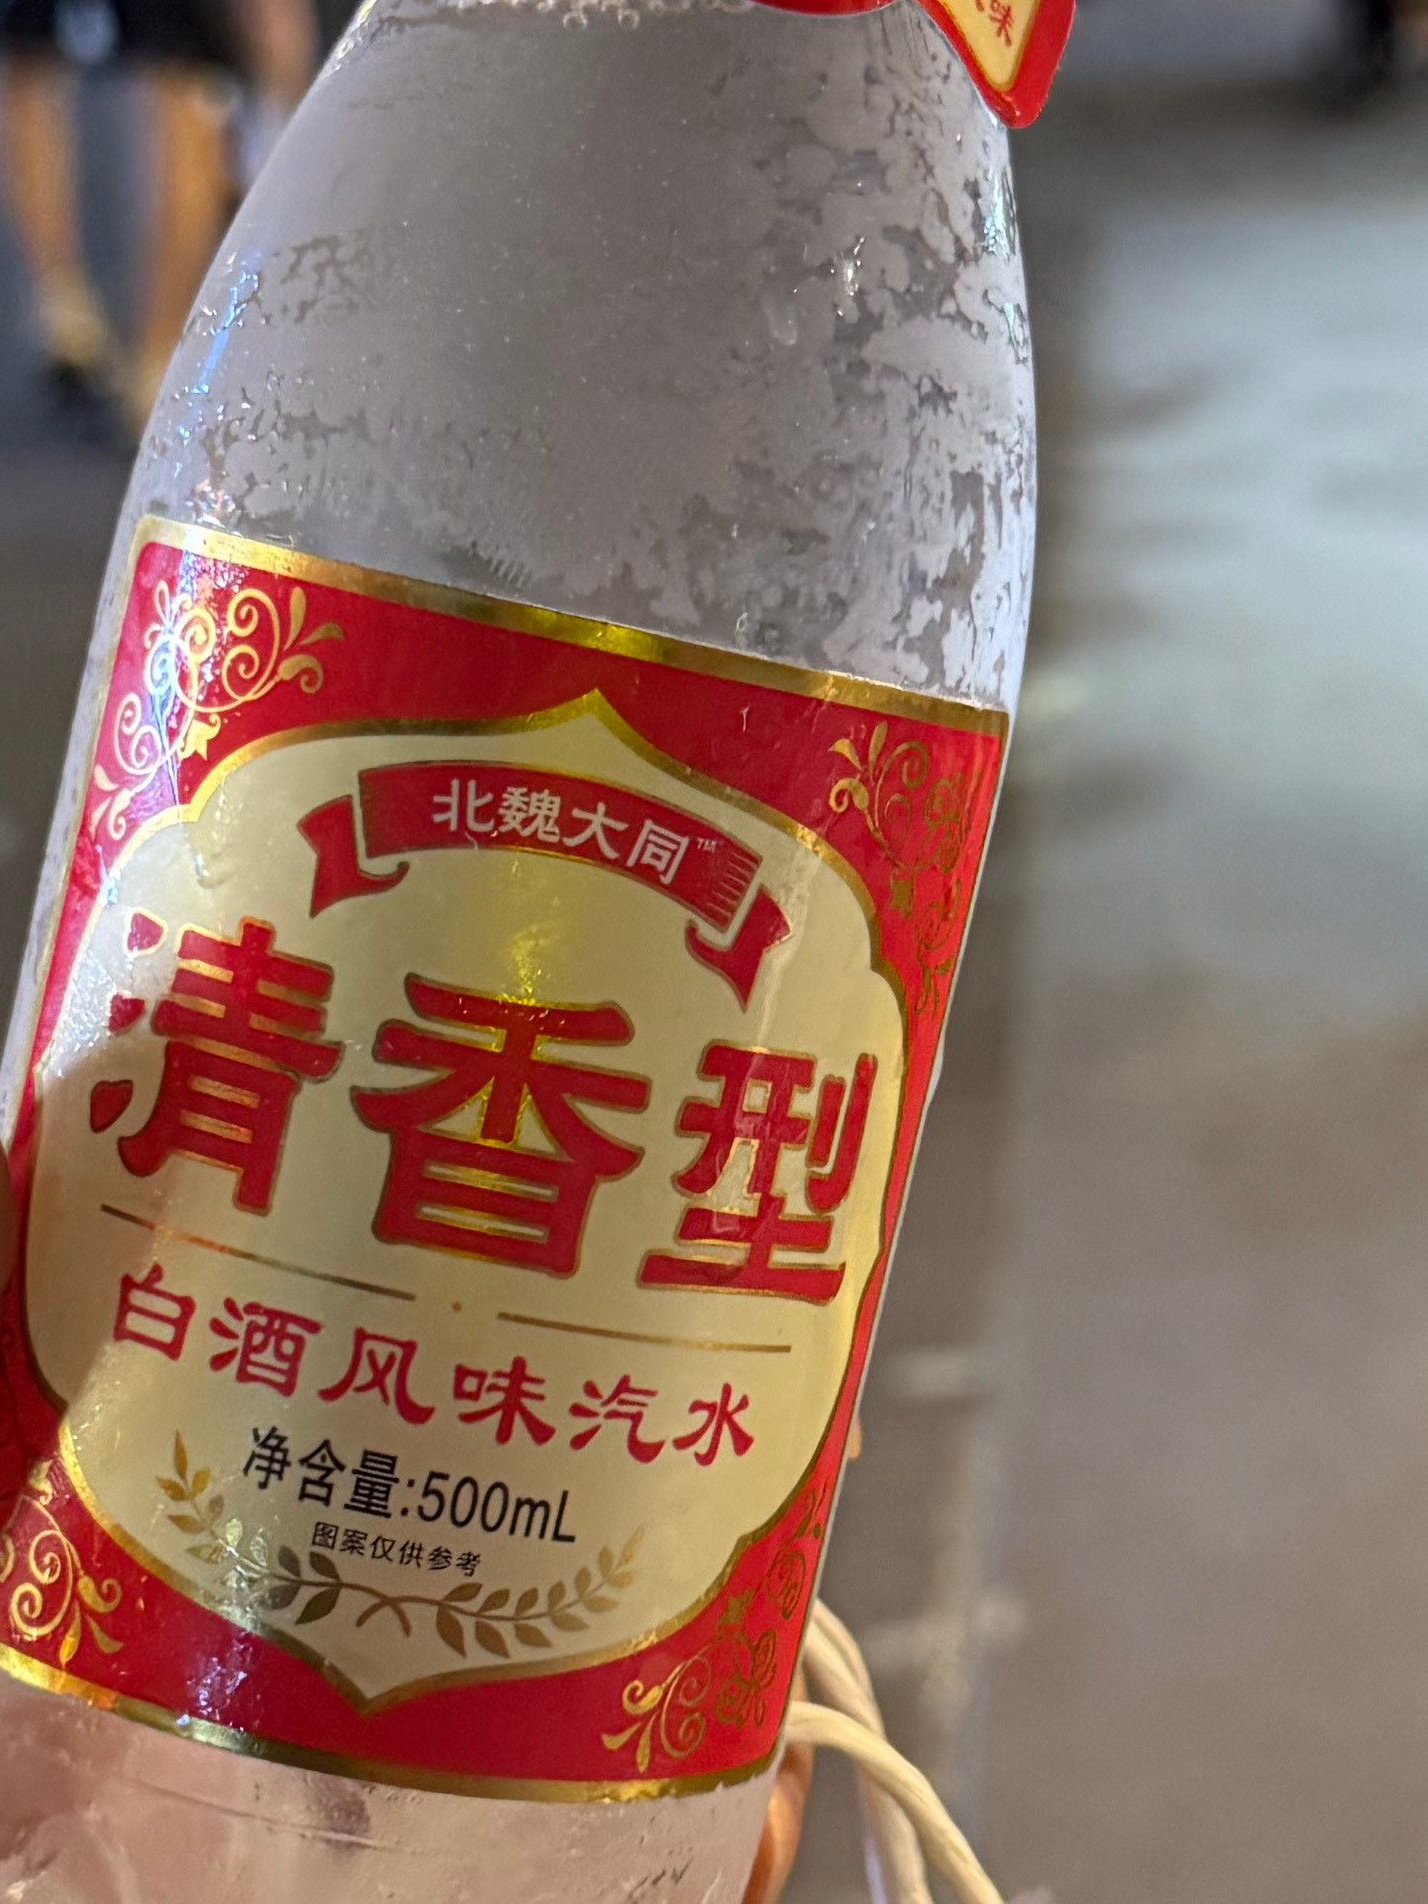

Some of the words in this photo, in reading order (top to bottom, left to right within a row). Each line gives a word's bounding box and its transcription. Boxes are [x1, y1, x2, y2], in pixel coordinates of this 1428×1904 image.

[432, 778, 689, 885] 北魏大同
[89, 907, 879, 1306] 清香型
[112, 1261, 755, 1466] 白酒风味汽水
[311, 1521, 482, 1577] 图案仅供参考
